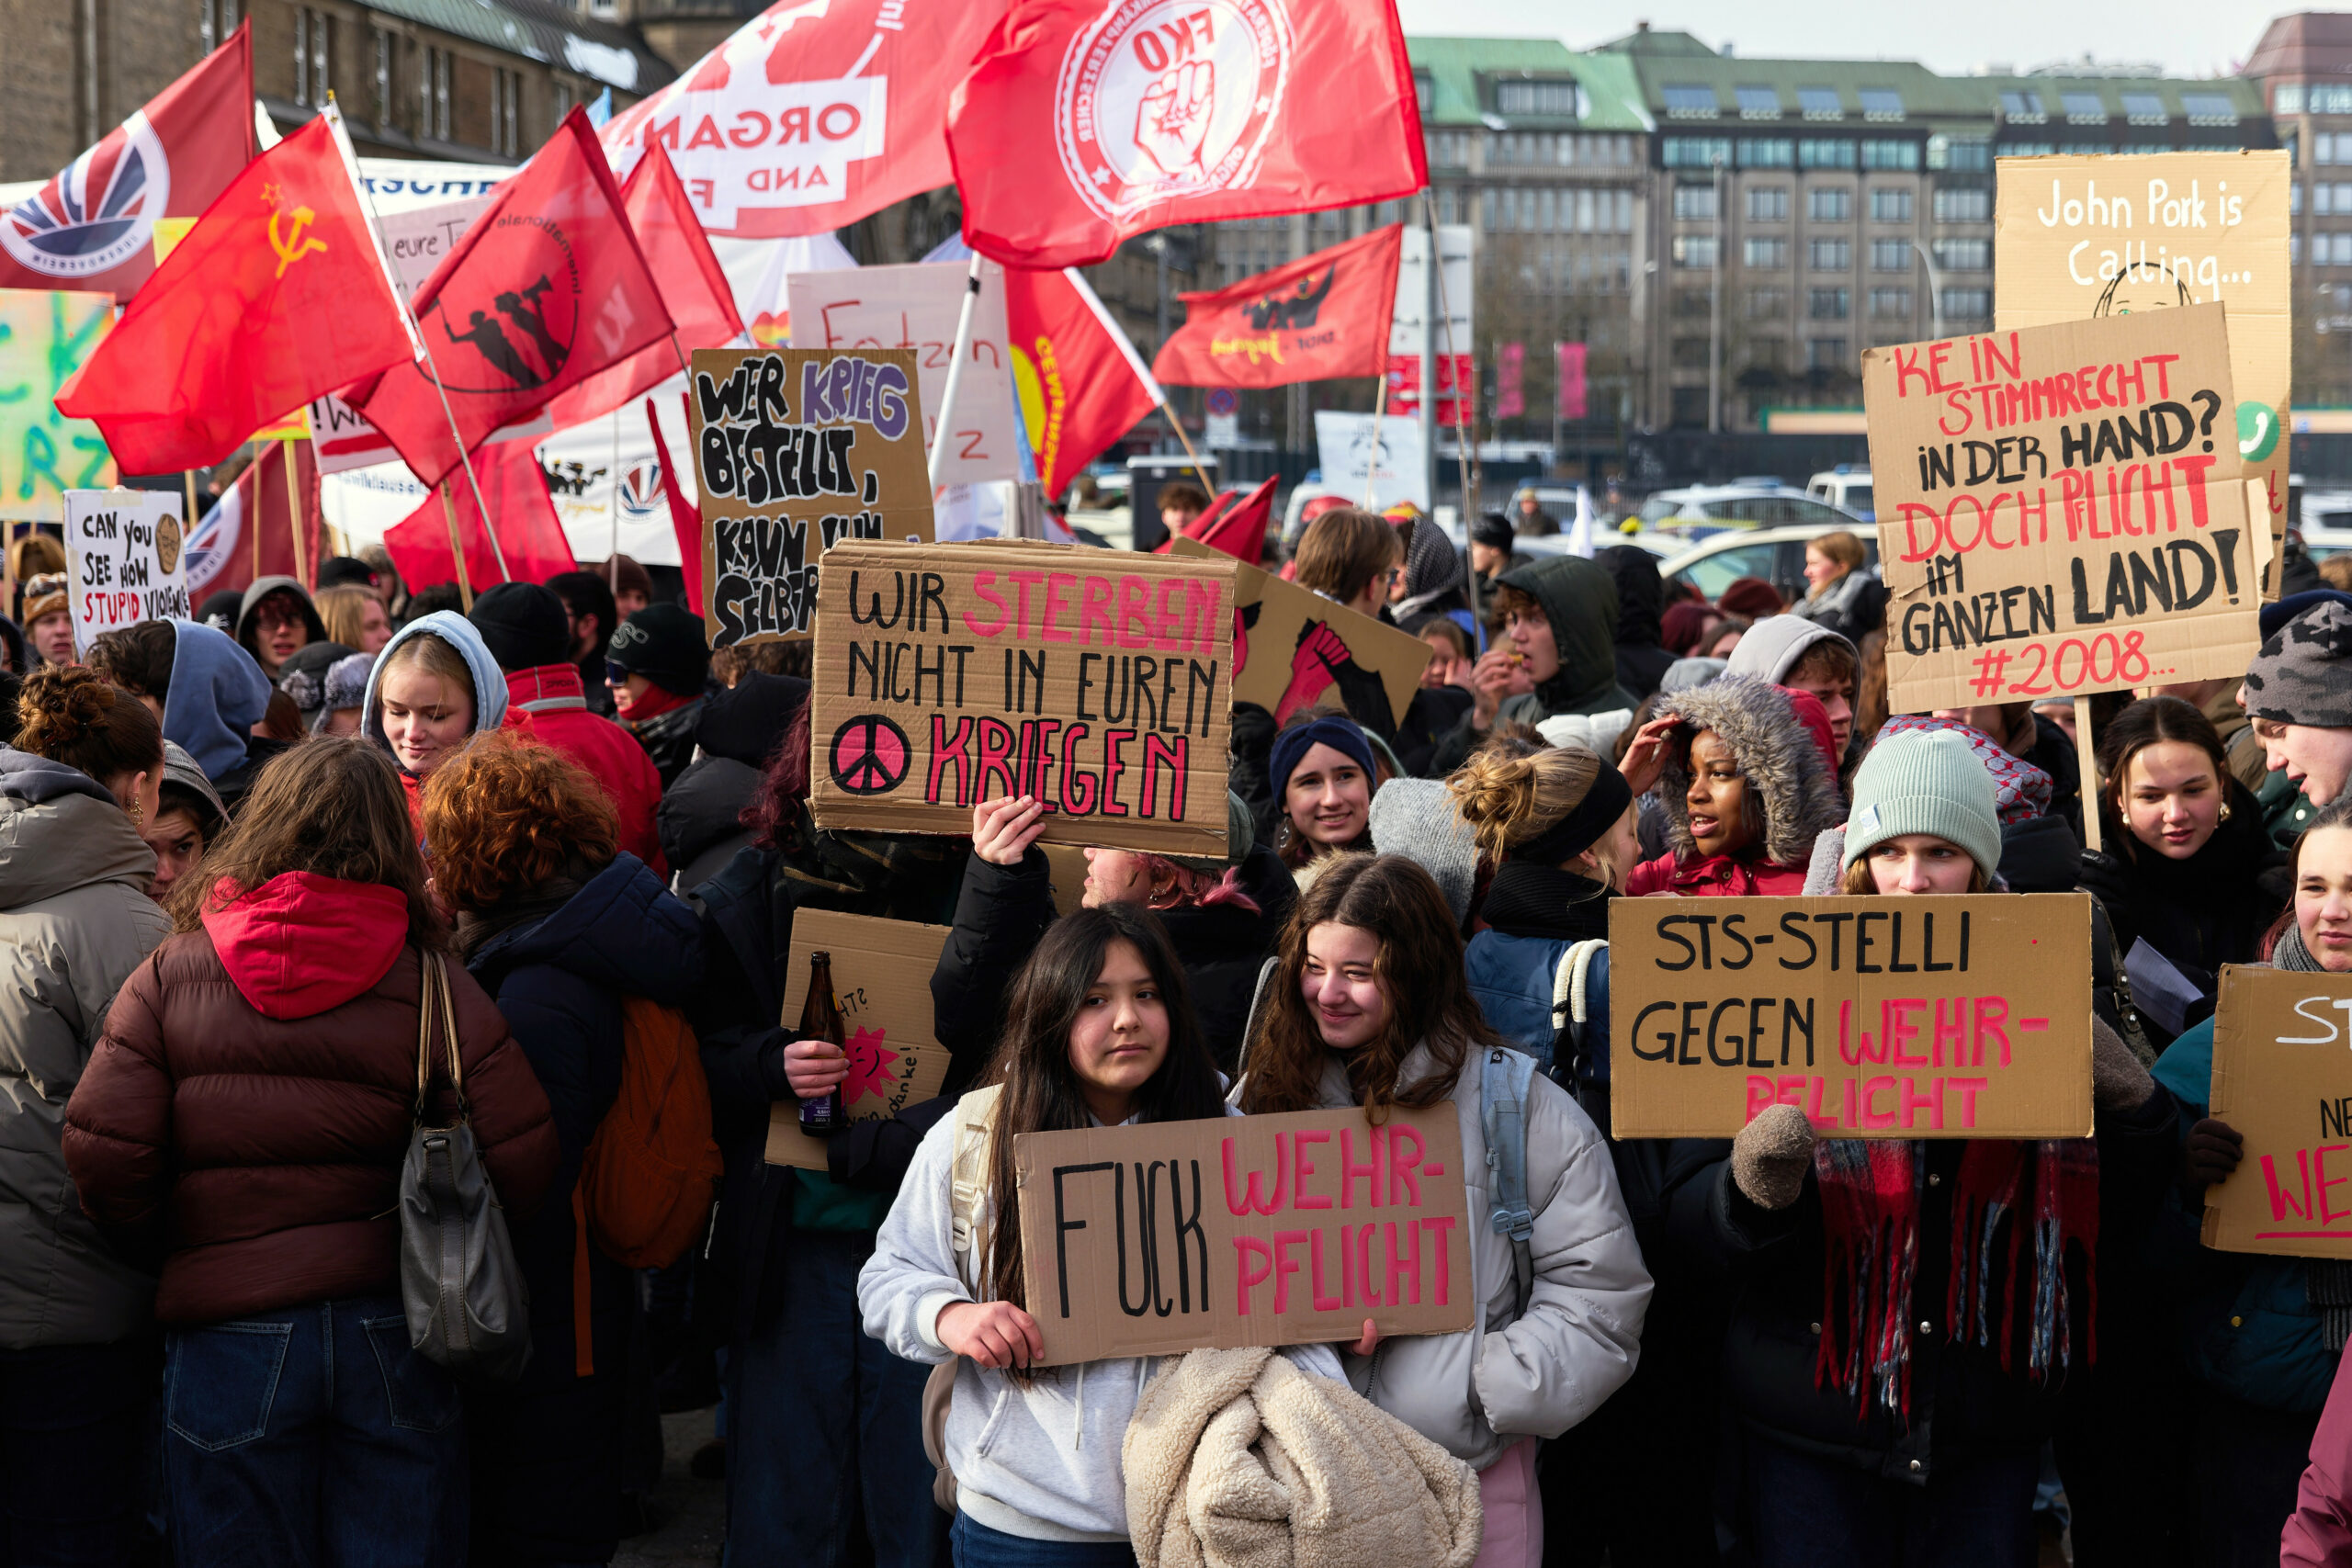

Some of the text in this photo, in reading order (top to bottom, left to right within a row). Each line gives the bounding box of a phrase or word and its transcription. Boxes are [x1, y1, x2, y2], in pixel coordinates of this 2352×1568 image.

[2037, 179, 2242, 228] John Pork is
[394, 235, 439, 259] eure
[695, 353, 789, 424] WER
[802, 355, 910, 442] KRIEG
[1961, 435, 2048, 486] DER
[2060, 389, 2222, 468] HAND?
[83, 511, 117, 538] CAN
[713, 513, 808, 581] KANN
[1896, 487, 2048, 563] DOCH
[83, 551, 112, 586] SEE
[120, 557, 149, 589] HOW
[1901, 527, 2241, 656] GANZEN LAND!
[84, 592, 140, 624] STUPID
[849, 570, 1222, 656] WIR STERBEN
[847, 640, 1218, 738] NICHT IN EUREN
[924, 713, 1190, 822] KRIEGEN
[1655, 910, 1971, 974] STS-STELLI
[1631, 995, 2050, 1070] GEGEN WEHR-
[1745, 1074, 1988, 1131] PFLICHT
[1053, 1122, 1444, 1319] FUCK WEHR-
[1232, 1216, 1456, 1316] PFLICHT
